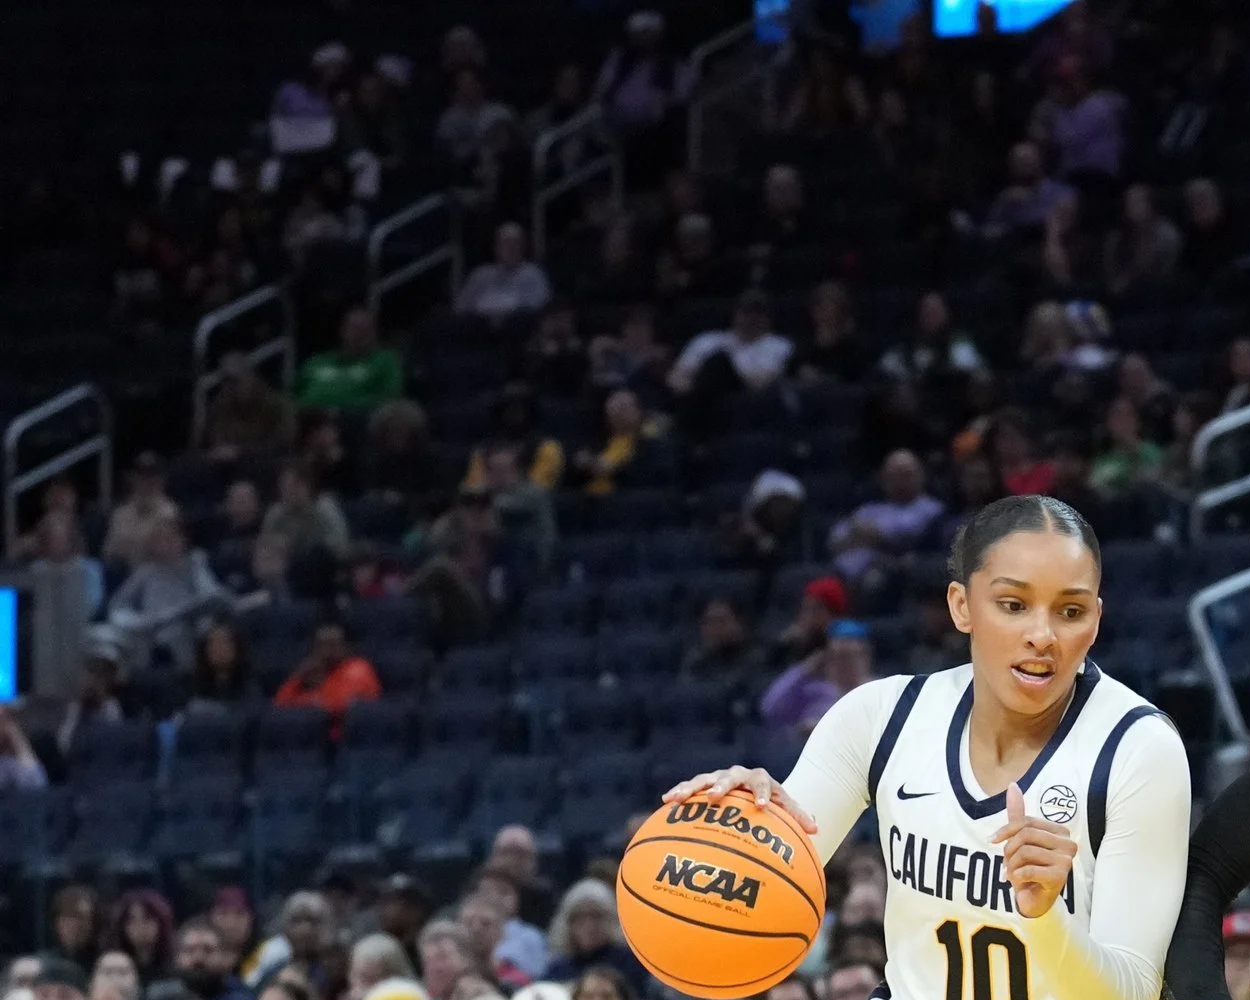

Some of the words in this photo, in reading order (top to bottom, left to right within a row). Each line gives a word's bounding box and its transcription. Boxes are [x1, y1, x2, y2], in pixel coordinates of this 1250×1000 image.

[1044, 796, 1077, 810] ACC
[665, 801, 795, 866] Wilson
[655, 854, 761, 909] NCAA
[889, 824, 1076, 915] CALIFOR
[693, 896, 722, 909] GAME
[724, 904, 751, 918] BALL
